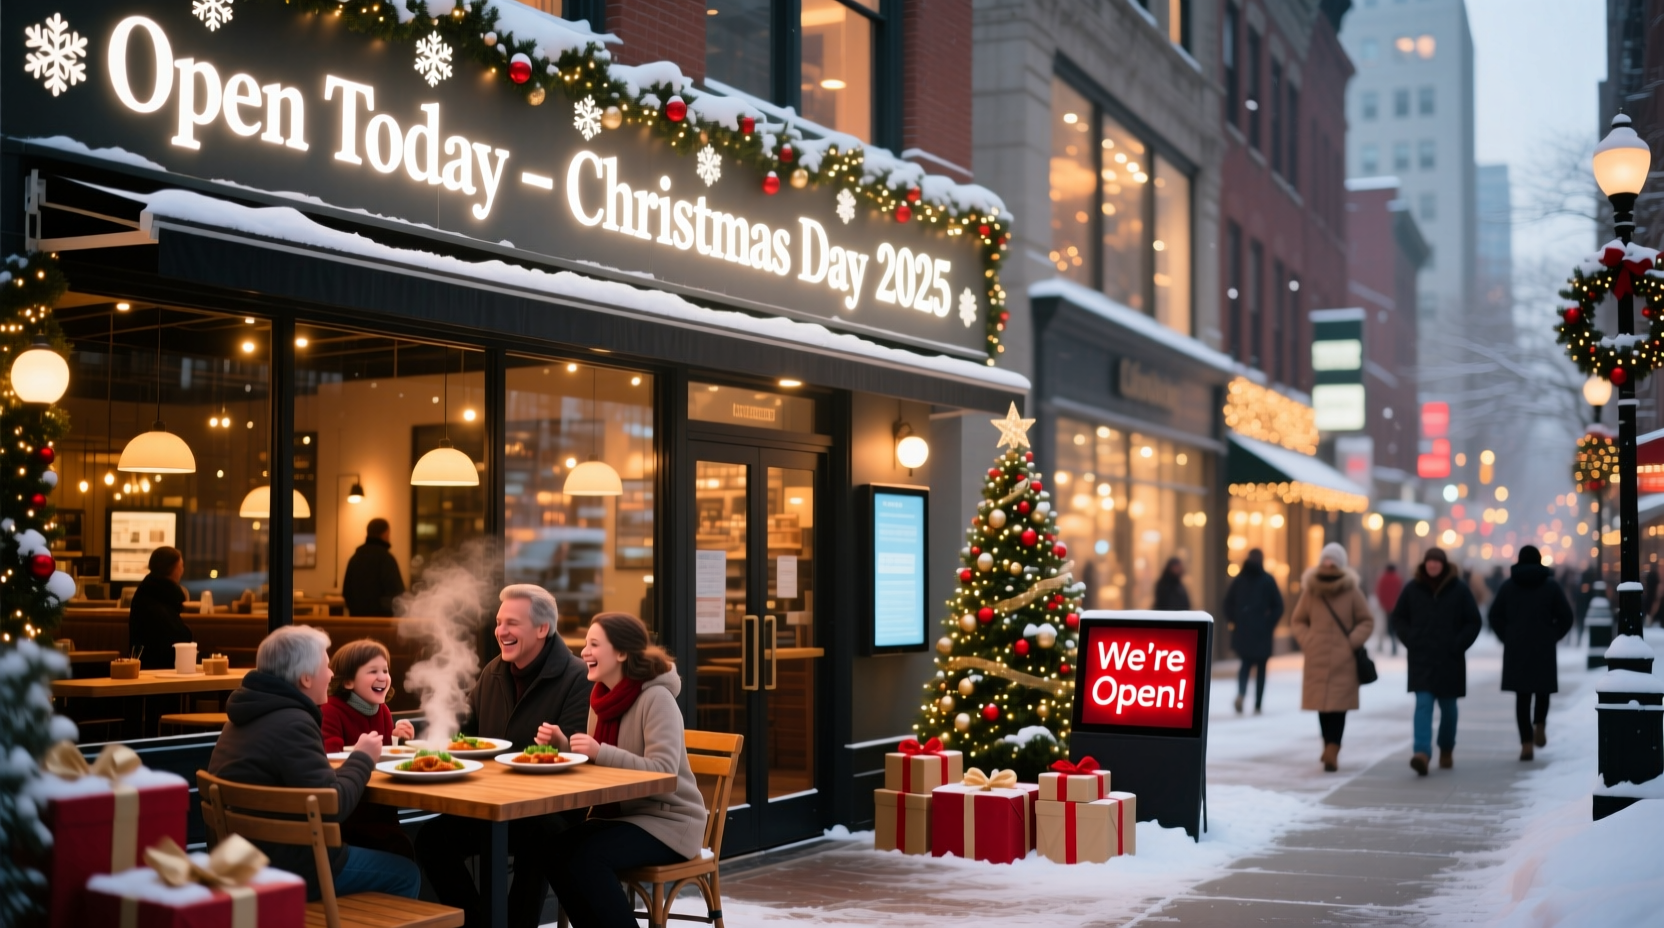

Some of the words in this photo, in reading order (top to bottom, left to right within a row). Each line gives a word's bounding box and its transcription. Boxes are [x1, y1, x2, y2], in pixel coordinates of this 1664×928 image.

[107, 15, 309, 151] Open
[324, 74, 510, 221] Today
[566, 149, 791, 277] Christmas
[797, 216, 869, 310] Day
[875, 242, 952, 318] 2025
[1097, 641, 1186, 672] We're
[1091, 675, 1187, 715] Open!
